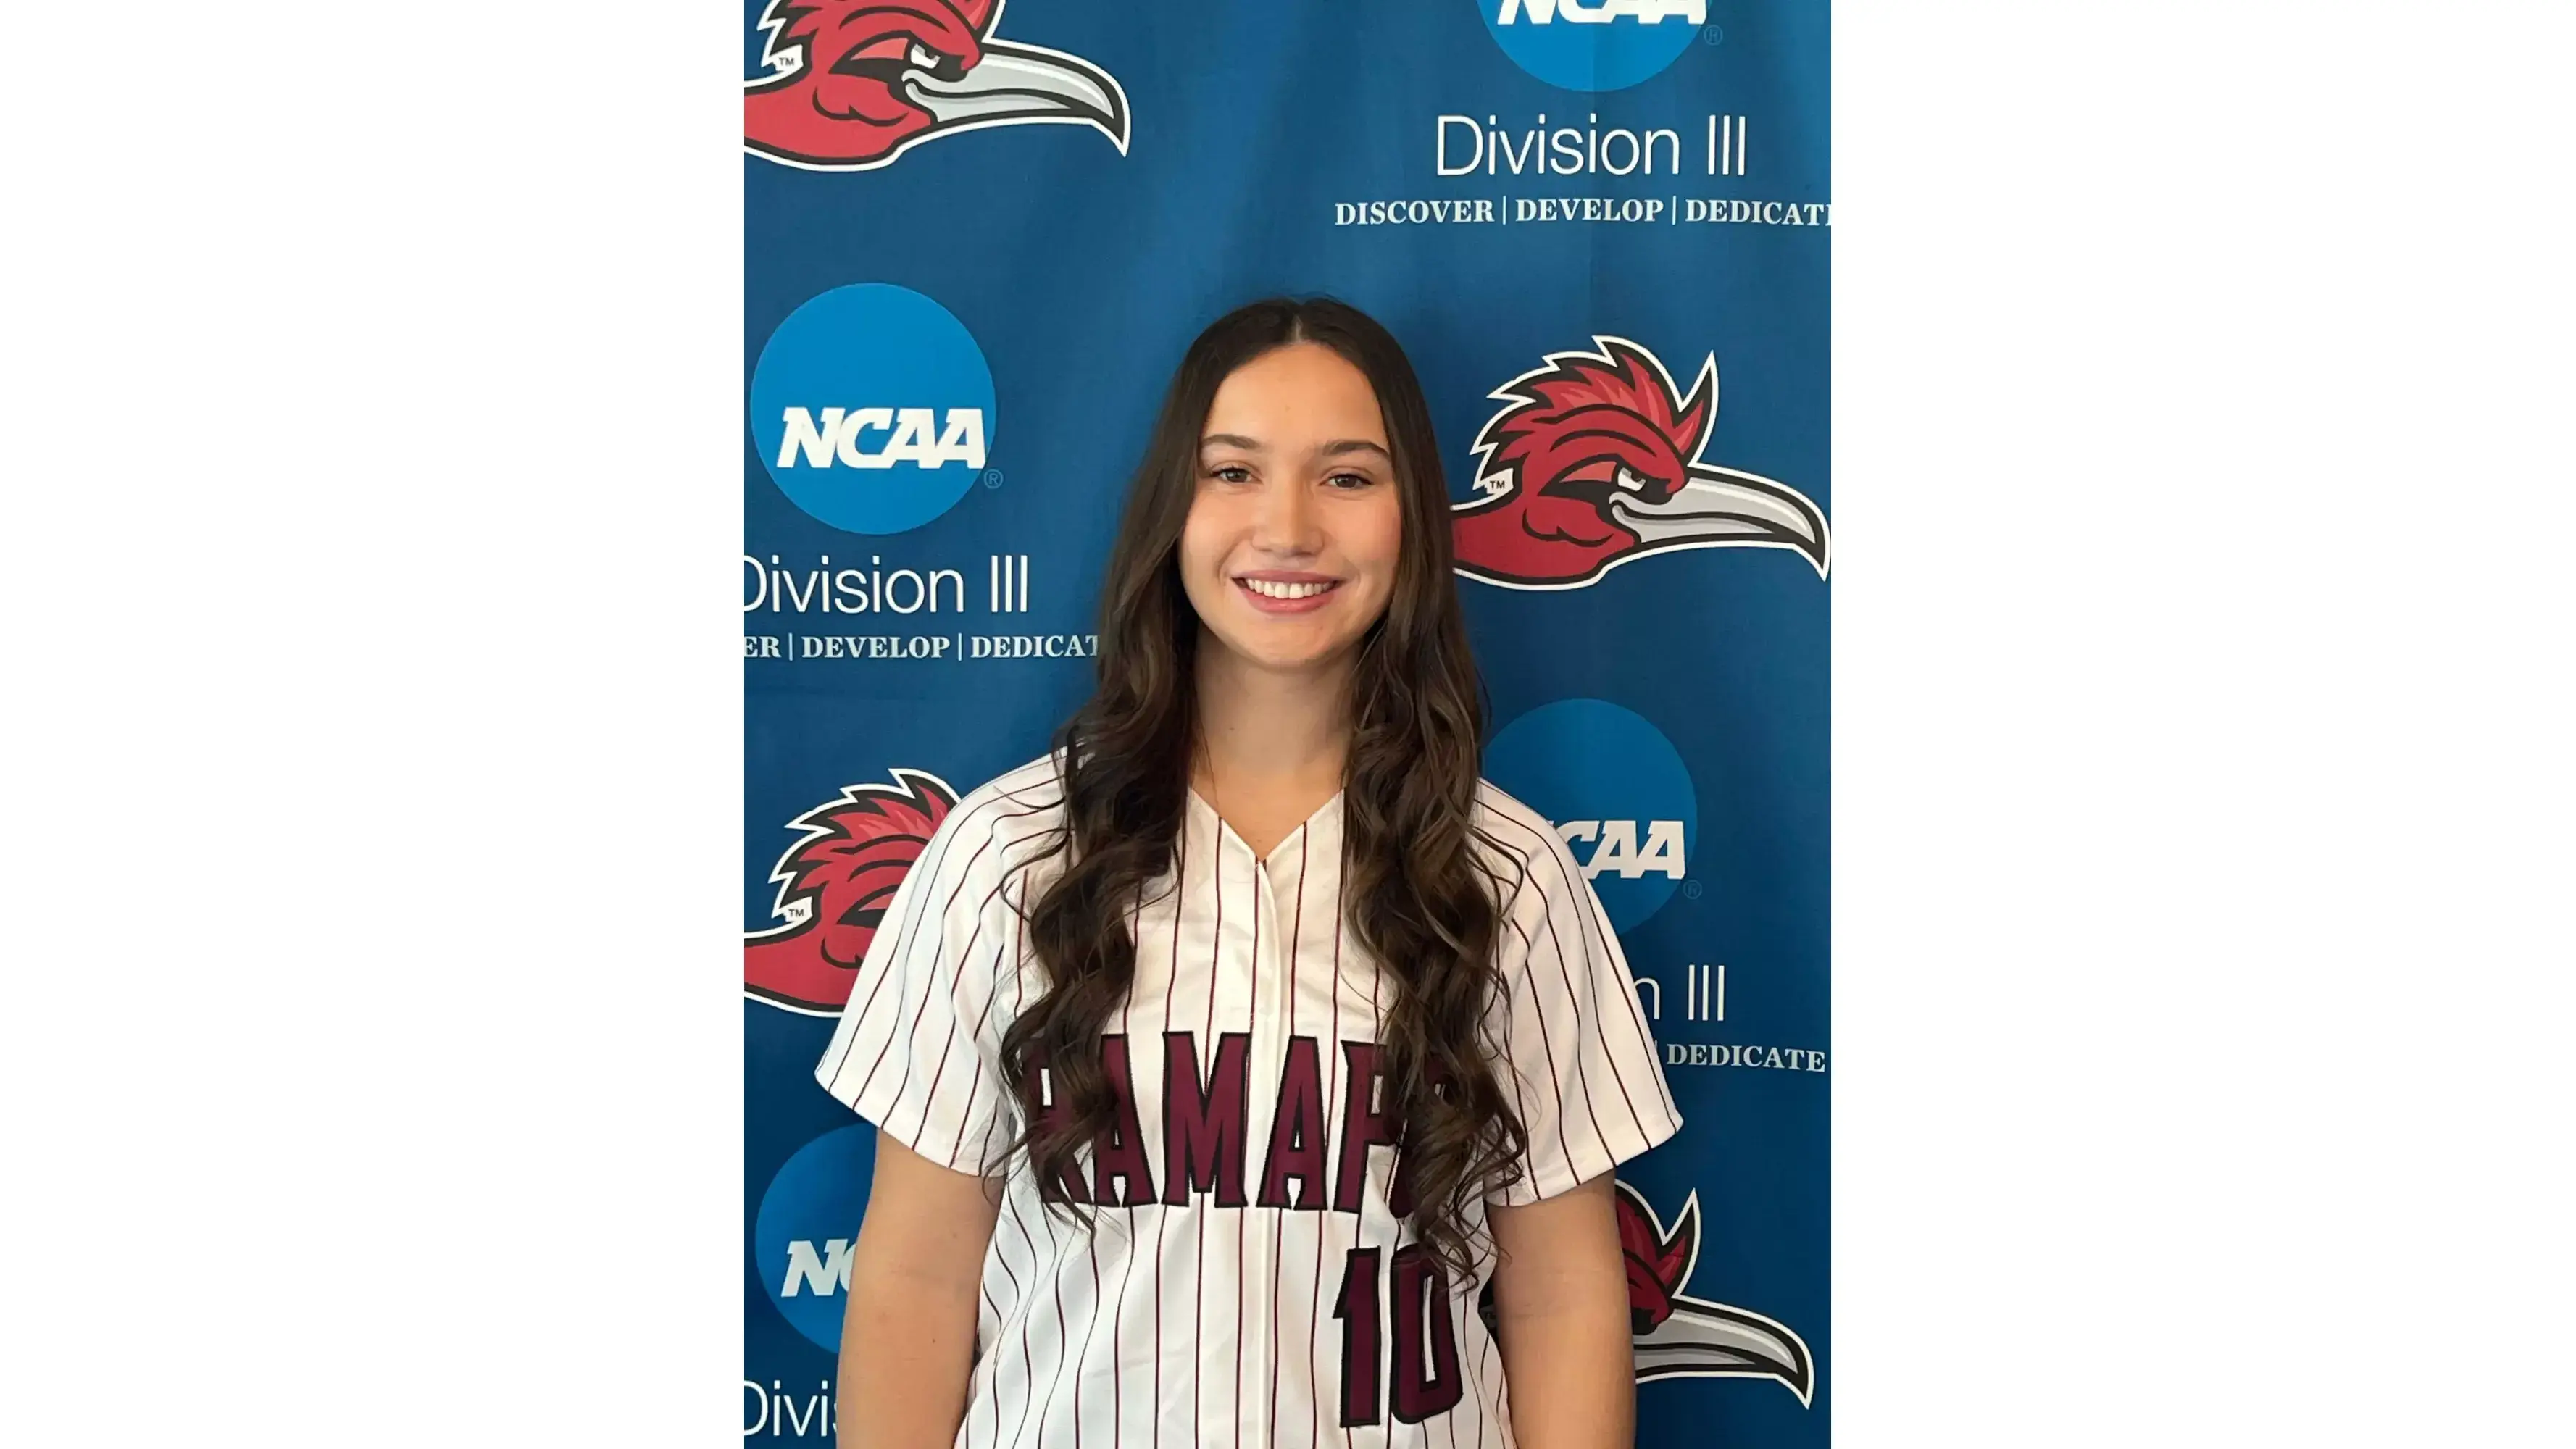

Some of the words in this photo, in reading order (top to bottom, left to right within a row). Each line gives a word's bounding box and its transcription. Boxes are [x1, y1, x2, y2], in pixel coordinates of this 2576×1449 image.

[1437, 113, 1680, 175] Division
[1708, 114, 1746, 175] III
[1335, 199, 1495, 225] DISCOVER
[1515, 198, 1664, 222] DEVELOP
[776, 406, 986, 469] NCAA
[1489, 480, 1505, 490] TM
[991, 554, 1028, 613] III
[801, 636, 950, 659] DEVELOP
[970, 635, 1099, 658] DEDICAT
[1548, 820, 1686, 880] CAA
[788, 908, 804, 917] TM
[1688, 964, 1725, 1022] III
[1667, 1044, 1825, 1073] DEDICATE
[1333, 1243, 1464, 1428] 10
